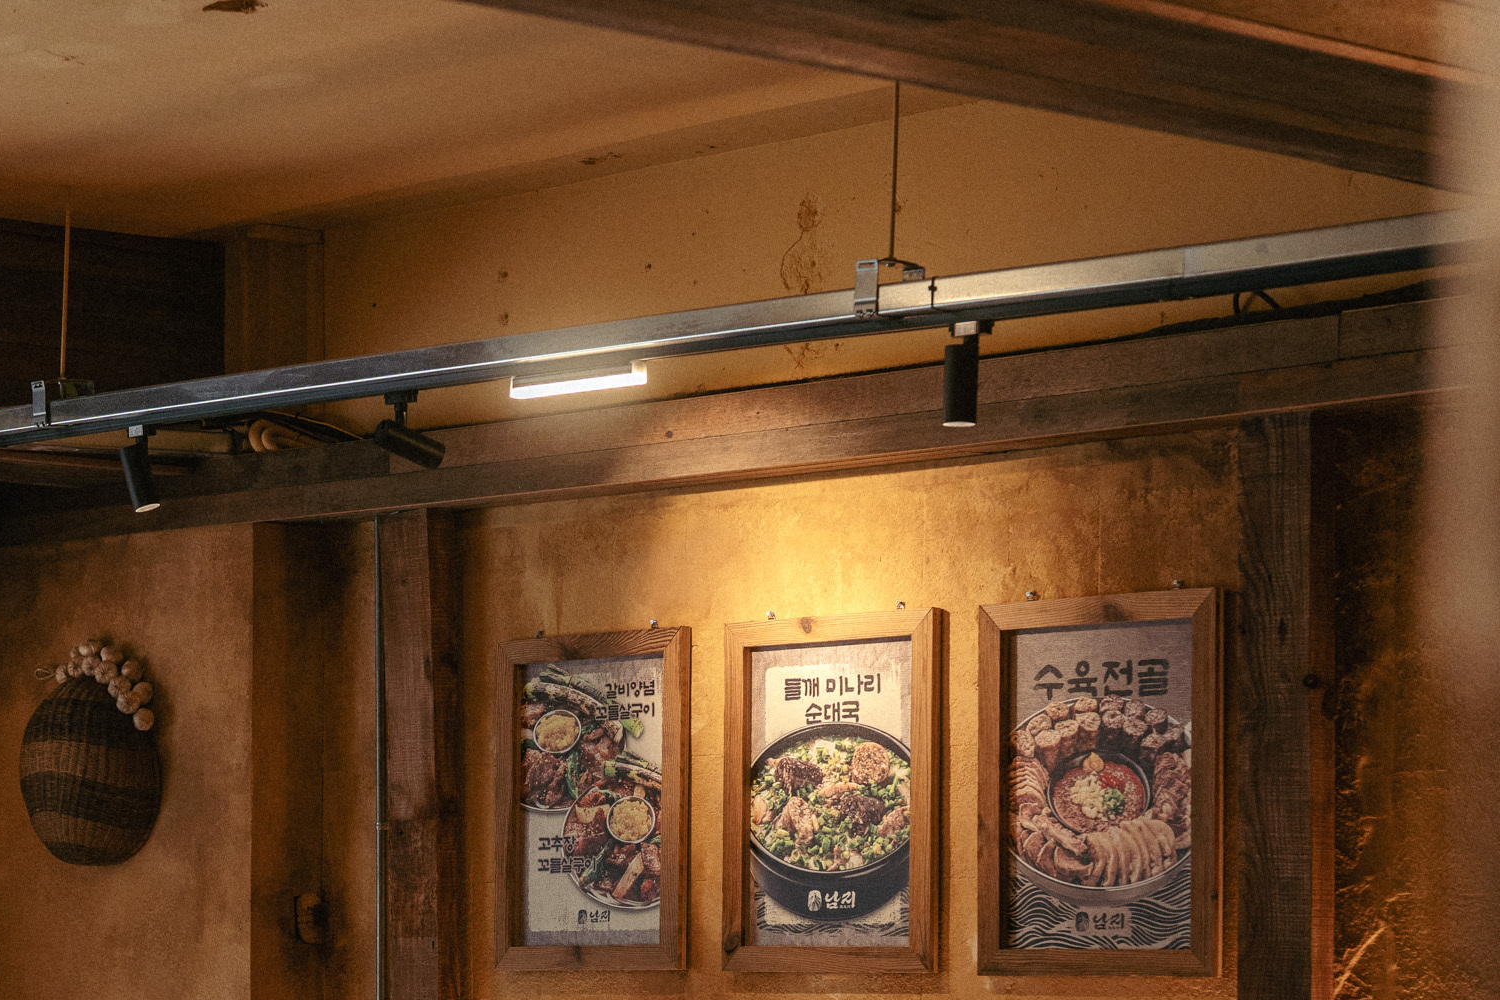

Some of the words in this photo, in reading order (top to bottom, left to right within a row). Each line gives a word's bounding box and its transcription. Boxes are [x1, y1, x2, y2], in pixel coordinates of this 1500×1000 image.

[784, 676, 820, 701] 들깨
[826, 673, 882, 696] 미나리
[1033, 658, 1170, 701] 수육전골
[605, 680, 655, 699] 갈비양념
[595, 702, 656, 720] 꼬들살구이
[805, 700, 860, 725] 순대국
[538, 835, 576, 853] 고추장
[538, 856, 597, 873] 꼬들살구이
